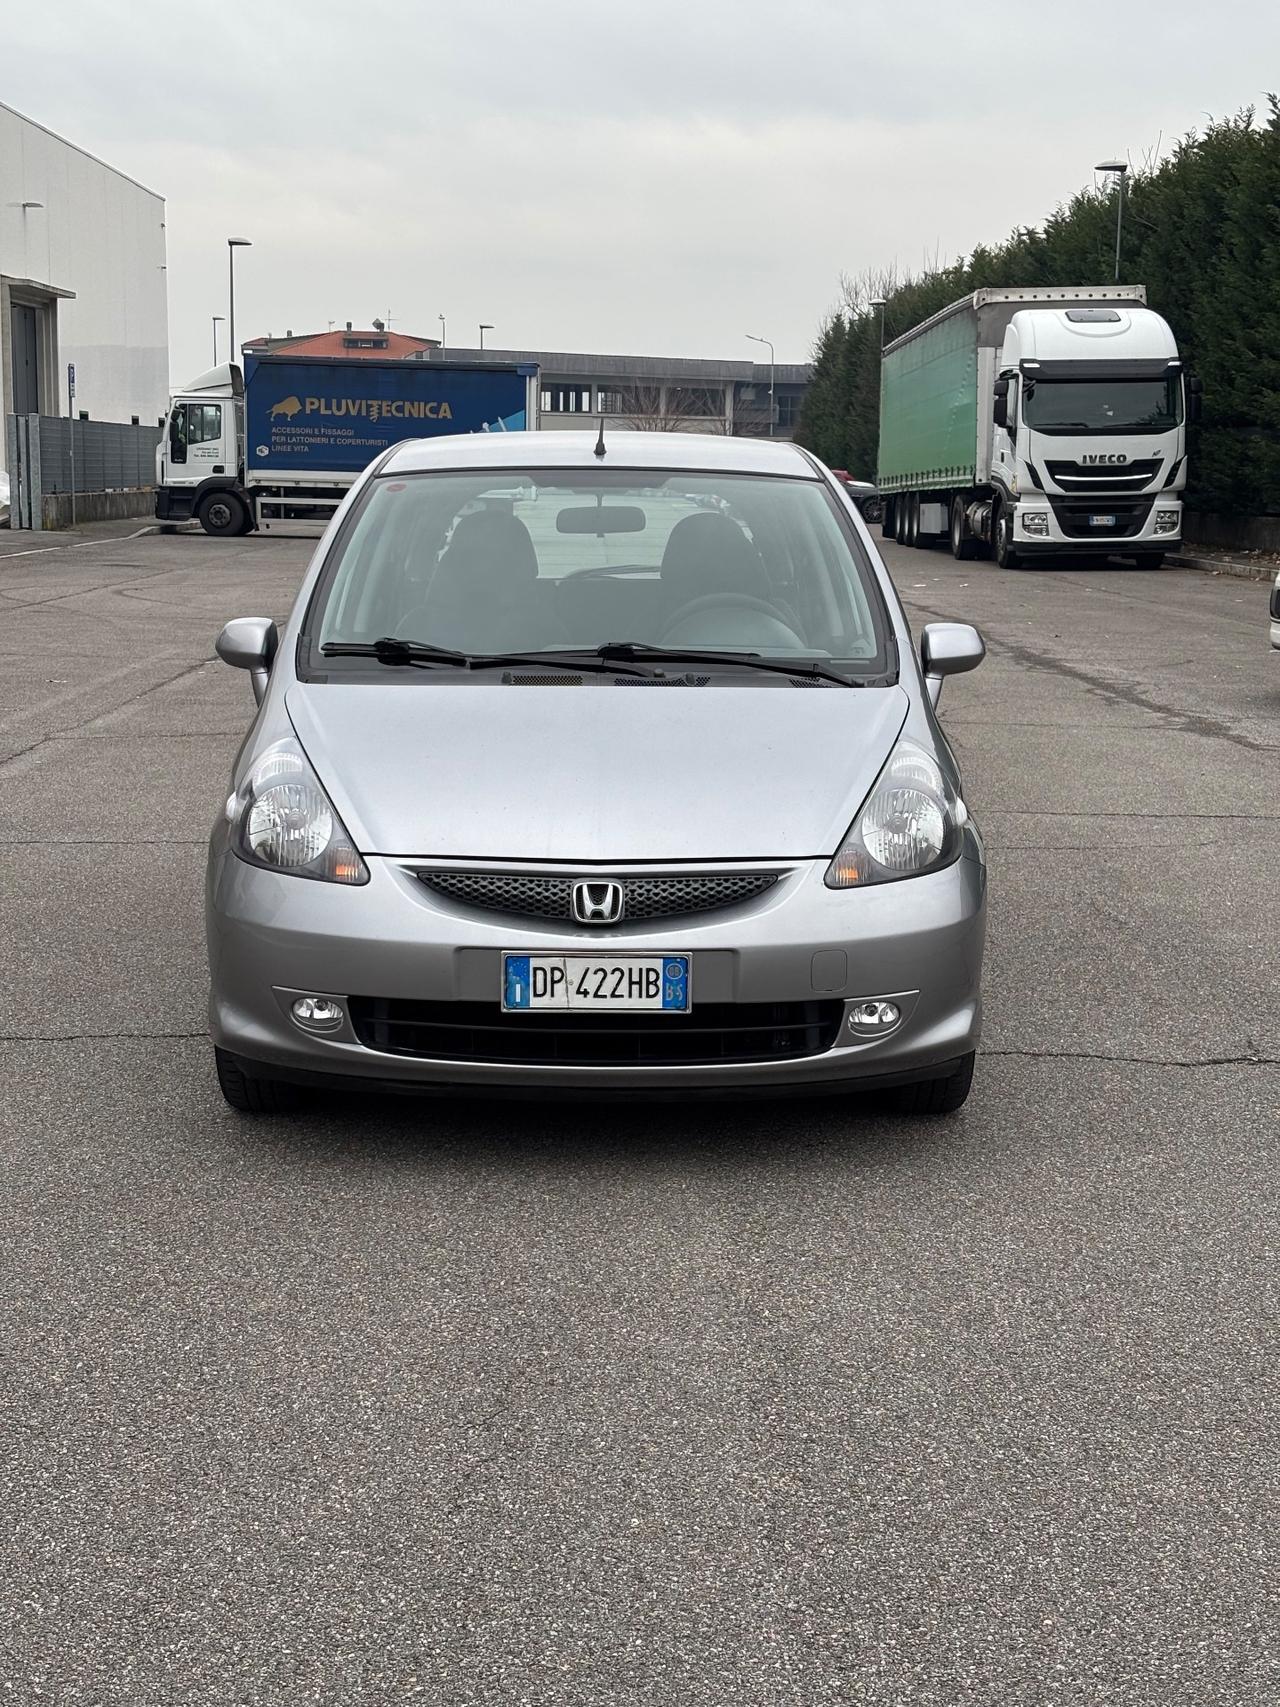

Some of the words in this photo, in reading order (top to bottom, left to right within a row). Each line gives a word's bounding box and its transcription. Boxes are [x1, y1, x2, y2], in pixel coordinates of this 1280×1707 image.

[305, 398, 452, 421] PLUVITECNICA
[321, 428, 354, 436] FISSAGGI
[288, 436, 329, 444] LATTONIERI
[337, 438, 388, 446] COPERTURISTI
[1082, 454, 1127, 465] IVECO
[532, 966, 564, 998] DP
[575, 966, 660, 999] 422HB
